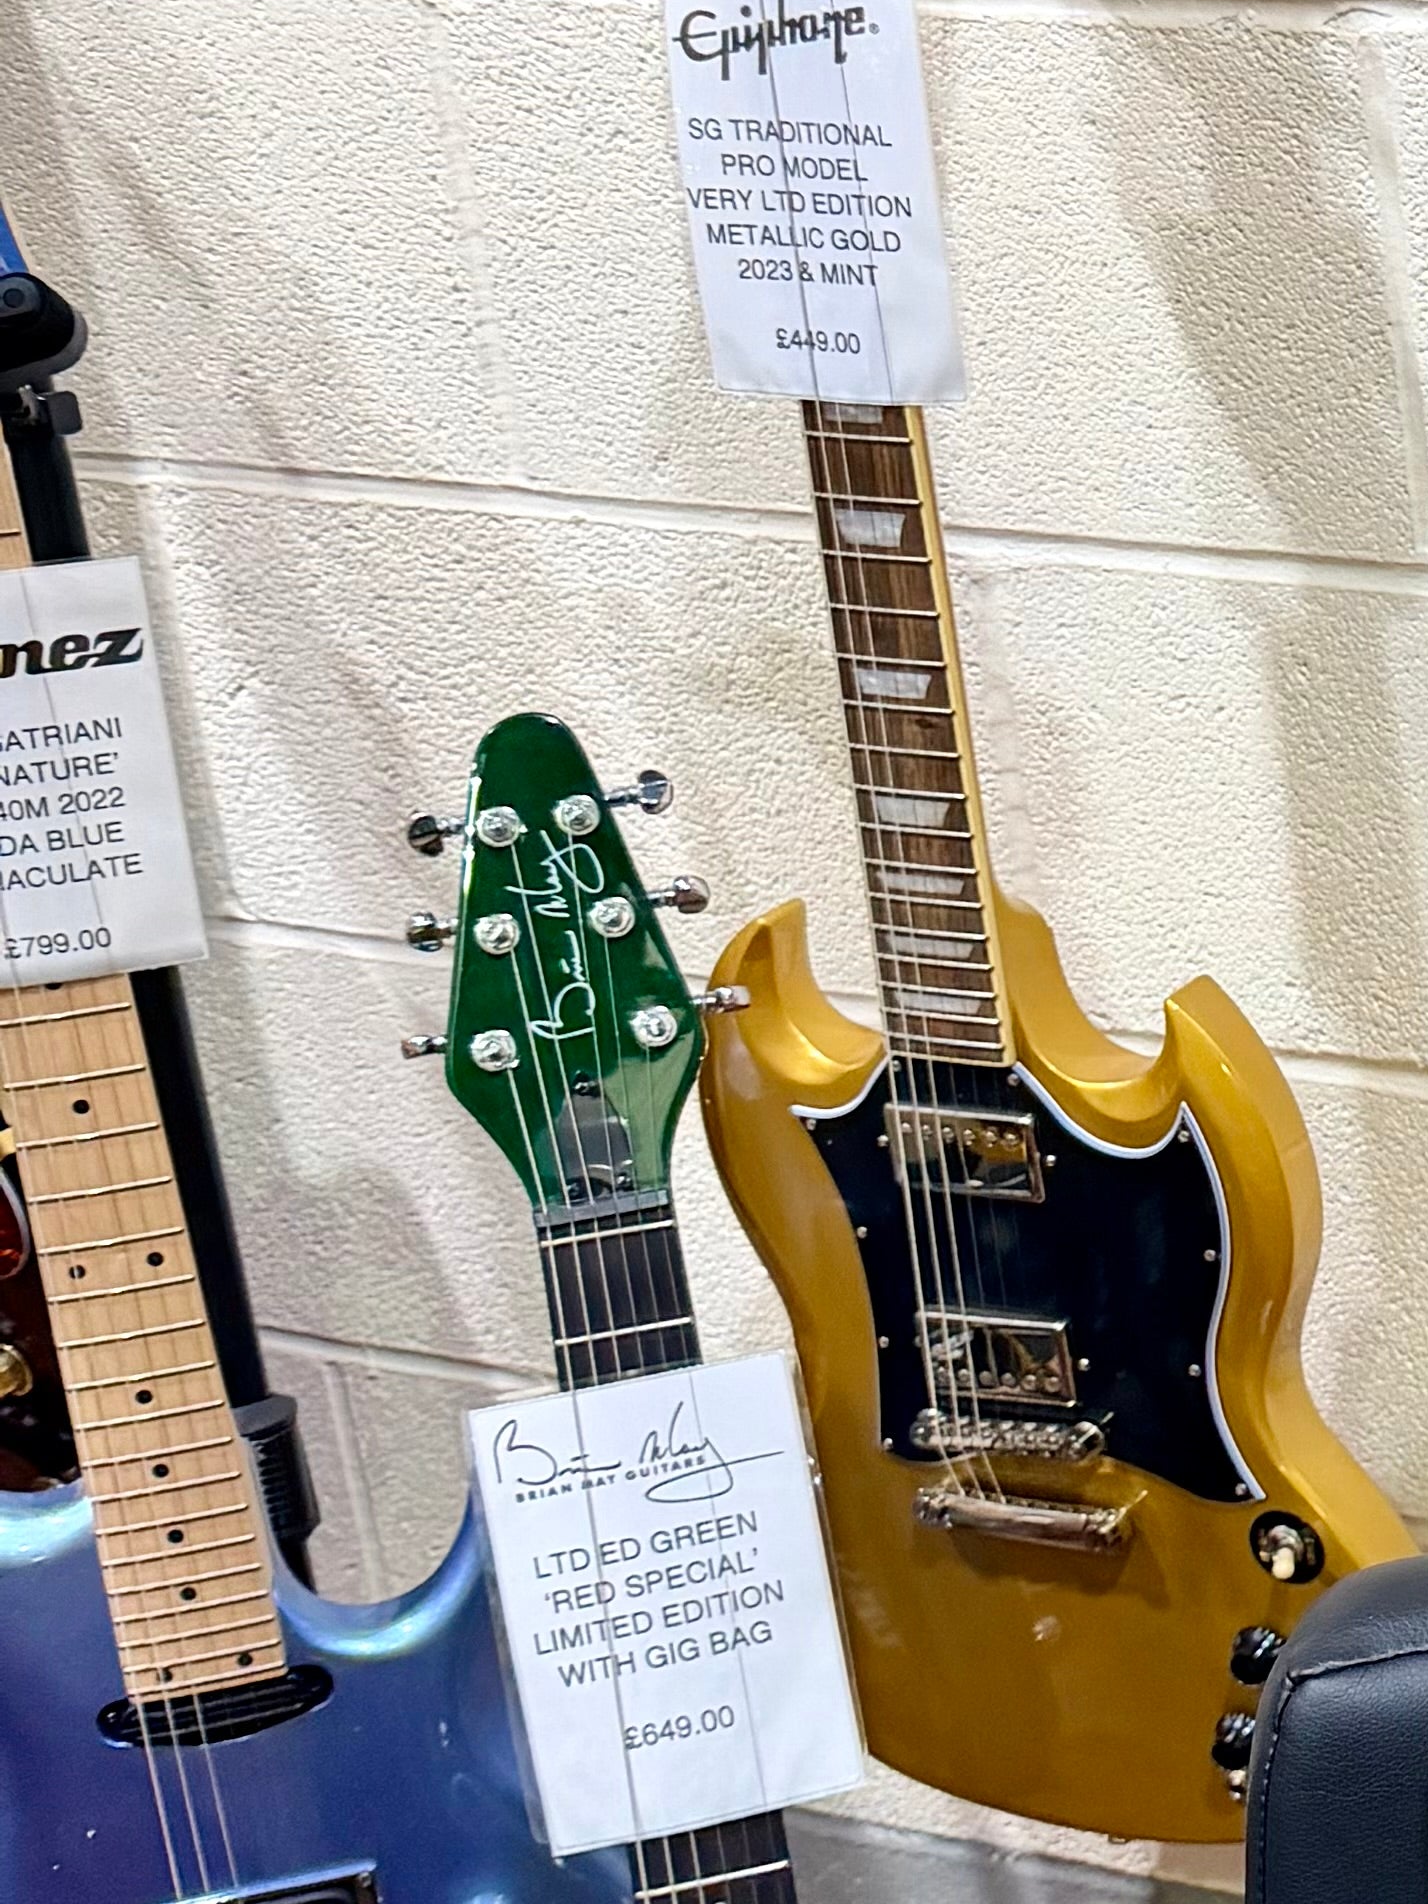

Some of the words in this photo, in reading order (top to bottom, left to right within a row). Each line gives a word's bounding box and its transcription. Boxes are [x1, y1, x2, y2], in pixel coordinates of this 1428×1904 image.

[688, 118, 722, 140] SG
[729, 119, 892, 146] TRADITIONAL
[721, 154, 775, 176] PRO
[784, 156, 868, 182] MODEL
[687, 188, 752, 211] VERY
[762, 191, 805, 213] LTD
[814, 193, 911, 217] EDITION
[706, 223, 824, 248] METALLIC
[831, 229, 900, 252] GOLD
[738, 258, 793, 281] 2023
[800, 261, 814, 282] &
[821, 262, 878, 286] MINT
[776, 329, 860, 354] £449.00
[0, 627, 144, 679] nez
[0, 752, 119, 788] NATURE'
[58, 786, 125, 815] 2022
[0, 833, 38, 857] DA
[47, 821, 125, 851] BLUE
[0, 852, 143, 893] ACULATE
[4, 927, 111, 959] £799.00
[515, 1482, 573, 1503] BRIAN
[625, 1455, 707, 1481] GUITARS
[533, 1546, 590, 1579] LTD
[599, 1537, 641, 1566] ED
[650, 1511, 758, 1554] GREEN
[544, 1582, 615, 1614] 'RED
[625, 1548, 759, 1598] SPECIAL'
[534, 1611, 653, 1656] LIMITED
[664, 1580, 785, 1628] EDITION
[558, 1653, 635, 1687] WITH
[645, 1639, 699, 1670] GIG
[709, 1620, 773, 1655] BAG
[624, 1705, 735, 1750] £649.00
